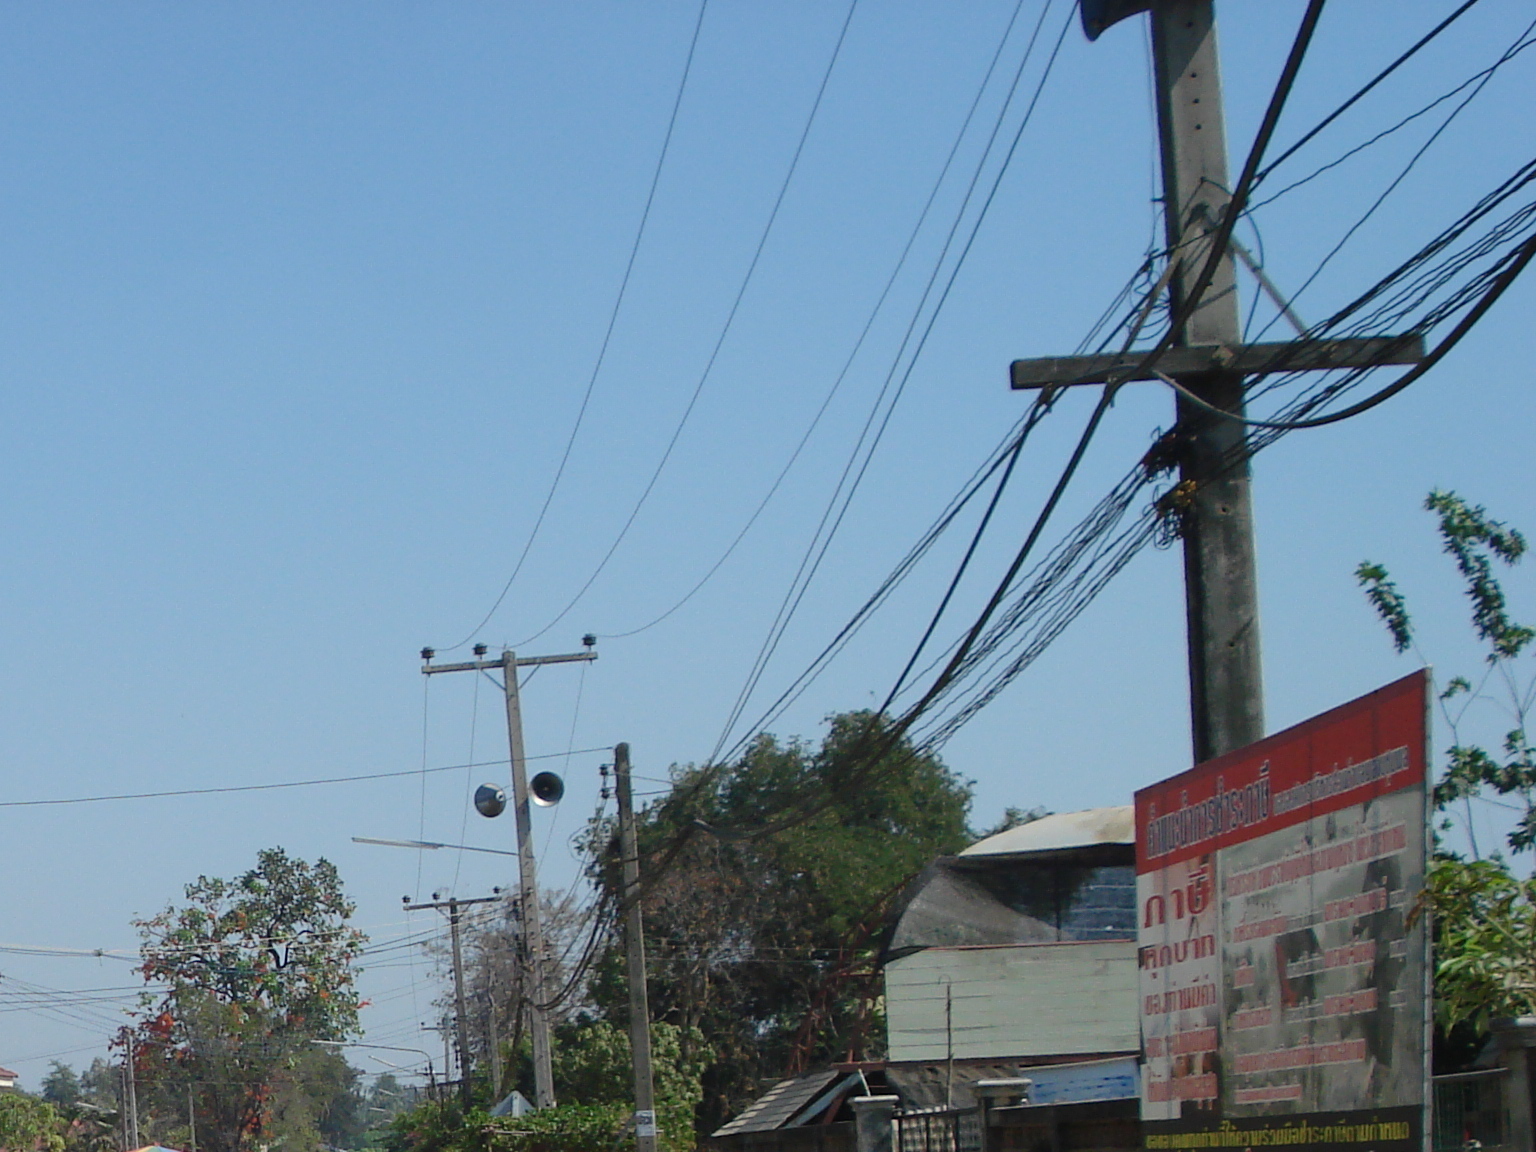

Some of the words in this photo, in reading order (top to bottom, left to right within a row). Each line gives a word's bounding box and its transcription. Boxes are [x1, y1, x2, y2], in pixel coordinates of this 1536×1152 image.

[1144, 865, 1211, 929] ภาษี
[1143, 934, 1216, 981] ทุกบาท
